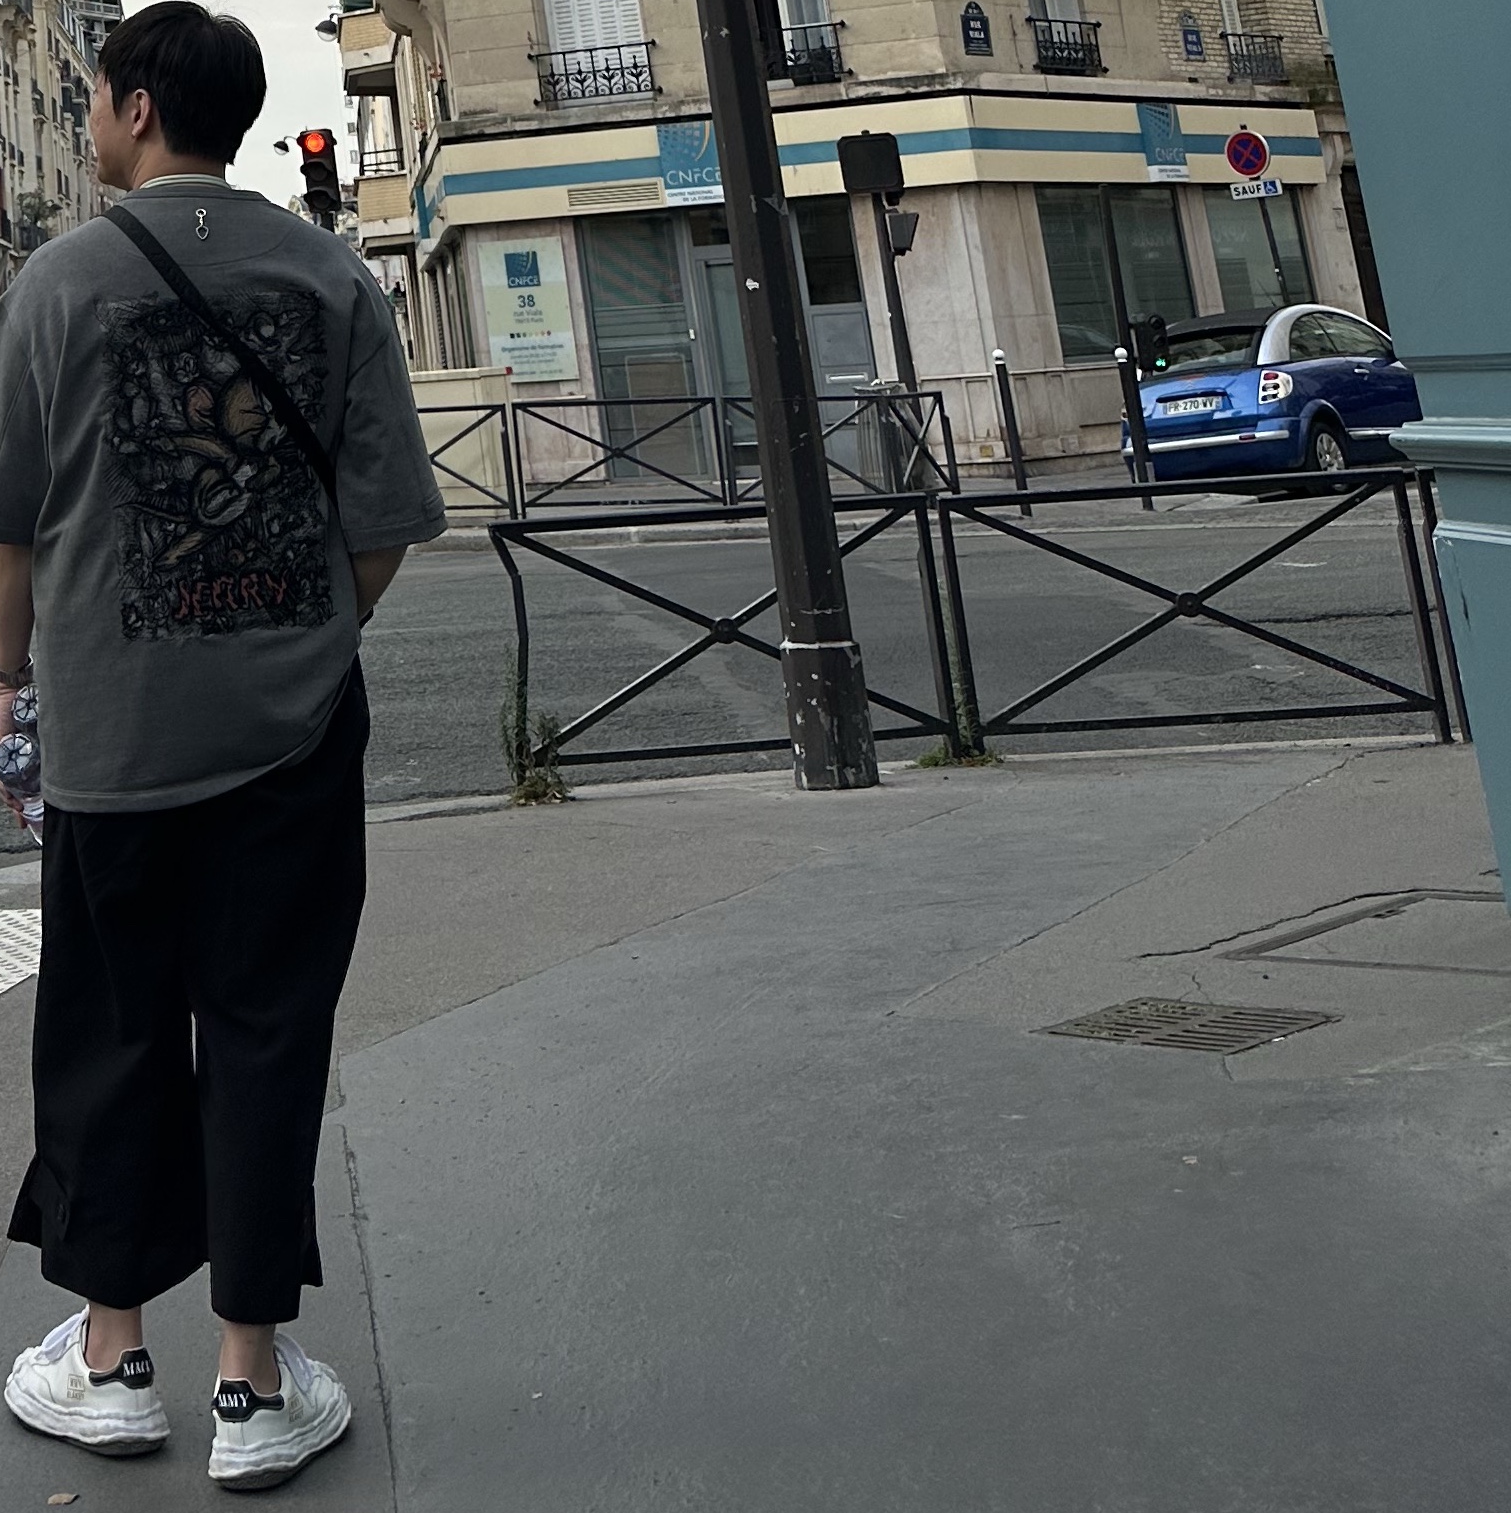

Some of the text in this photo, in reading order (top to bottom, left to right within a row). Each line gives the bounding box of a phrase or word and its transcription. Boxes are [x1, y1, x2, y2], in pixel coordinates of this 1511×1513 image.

[1233, 183, 1263, 197] SAUF
[508, 275, 540, 287] CNFCE
[518, 294, 536, 308] 38
